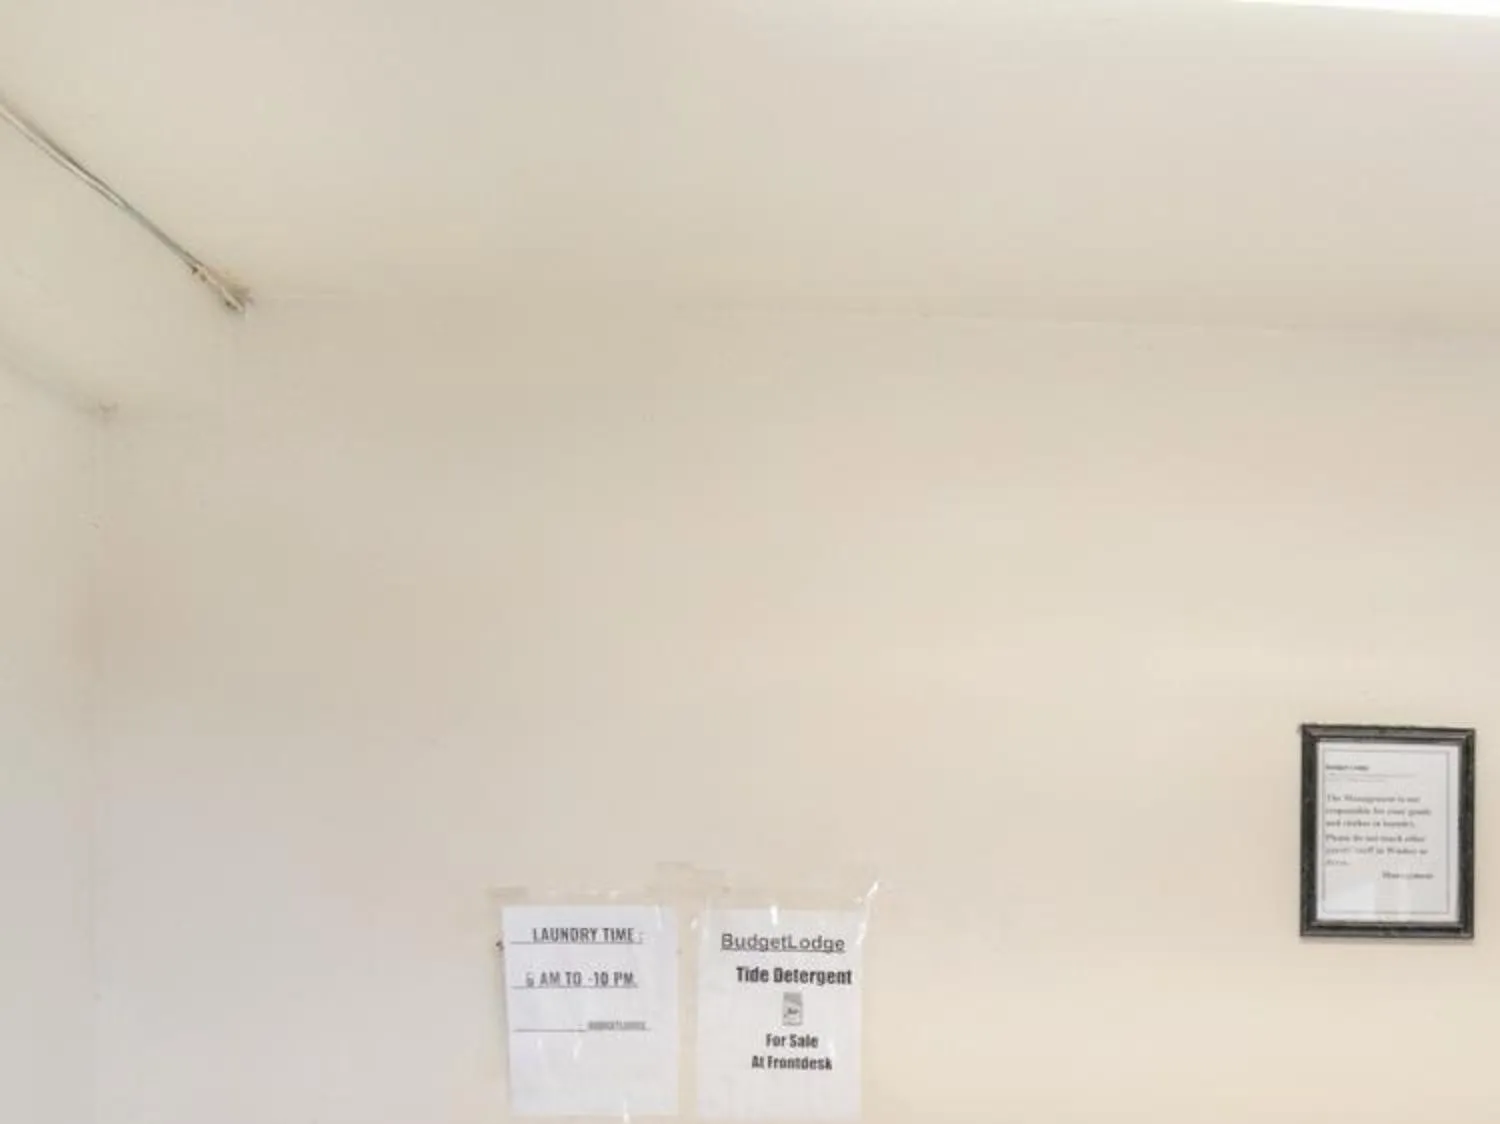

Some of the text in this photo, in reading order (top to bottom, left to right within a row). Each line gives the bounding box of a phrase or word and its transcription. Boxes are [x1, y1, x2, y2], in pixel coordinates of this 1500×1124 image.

[532, 927, 599, 942] LAUNDRY
[721, 933, 847, 954] BudgetLodge
[540, 971, 561, 986] AM
[565, 971, 582, 986] TO
[736, 966, 853, 986] Tide Detergent
[765, 1033, 819, 1049] For Sale
[751, 1055, 833, 1070] At Frontdesk
